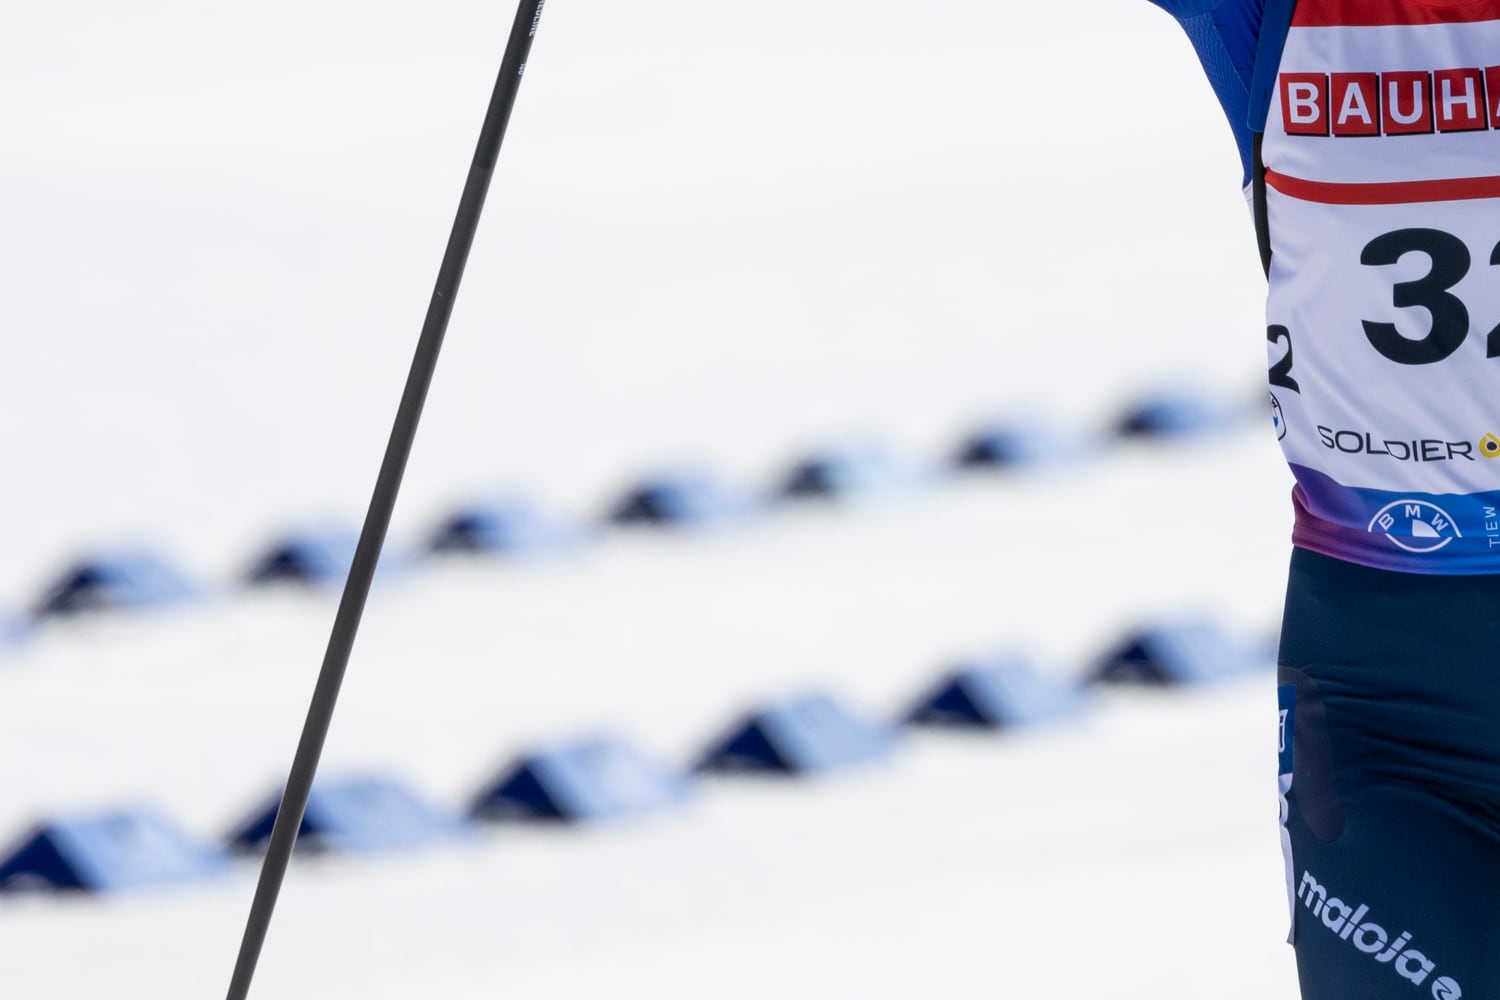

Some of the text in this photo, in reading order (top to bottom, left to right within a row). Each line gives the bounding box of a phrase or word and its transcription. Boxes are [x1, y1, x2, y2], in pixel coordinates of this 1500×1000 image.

[1316, 424, 1476, 463] SOLDIER
[1377, 504, 1450, 532] BMW
[1297, 869, 1437, 986] maloja
